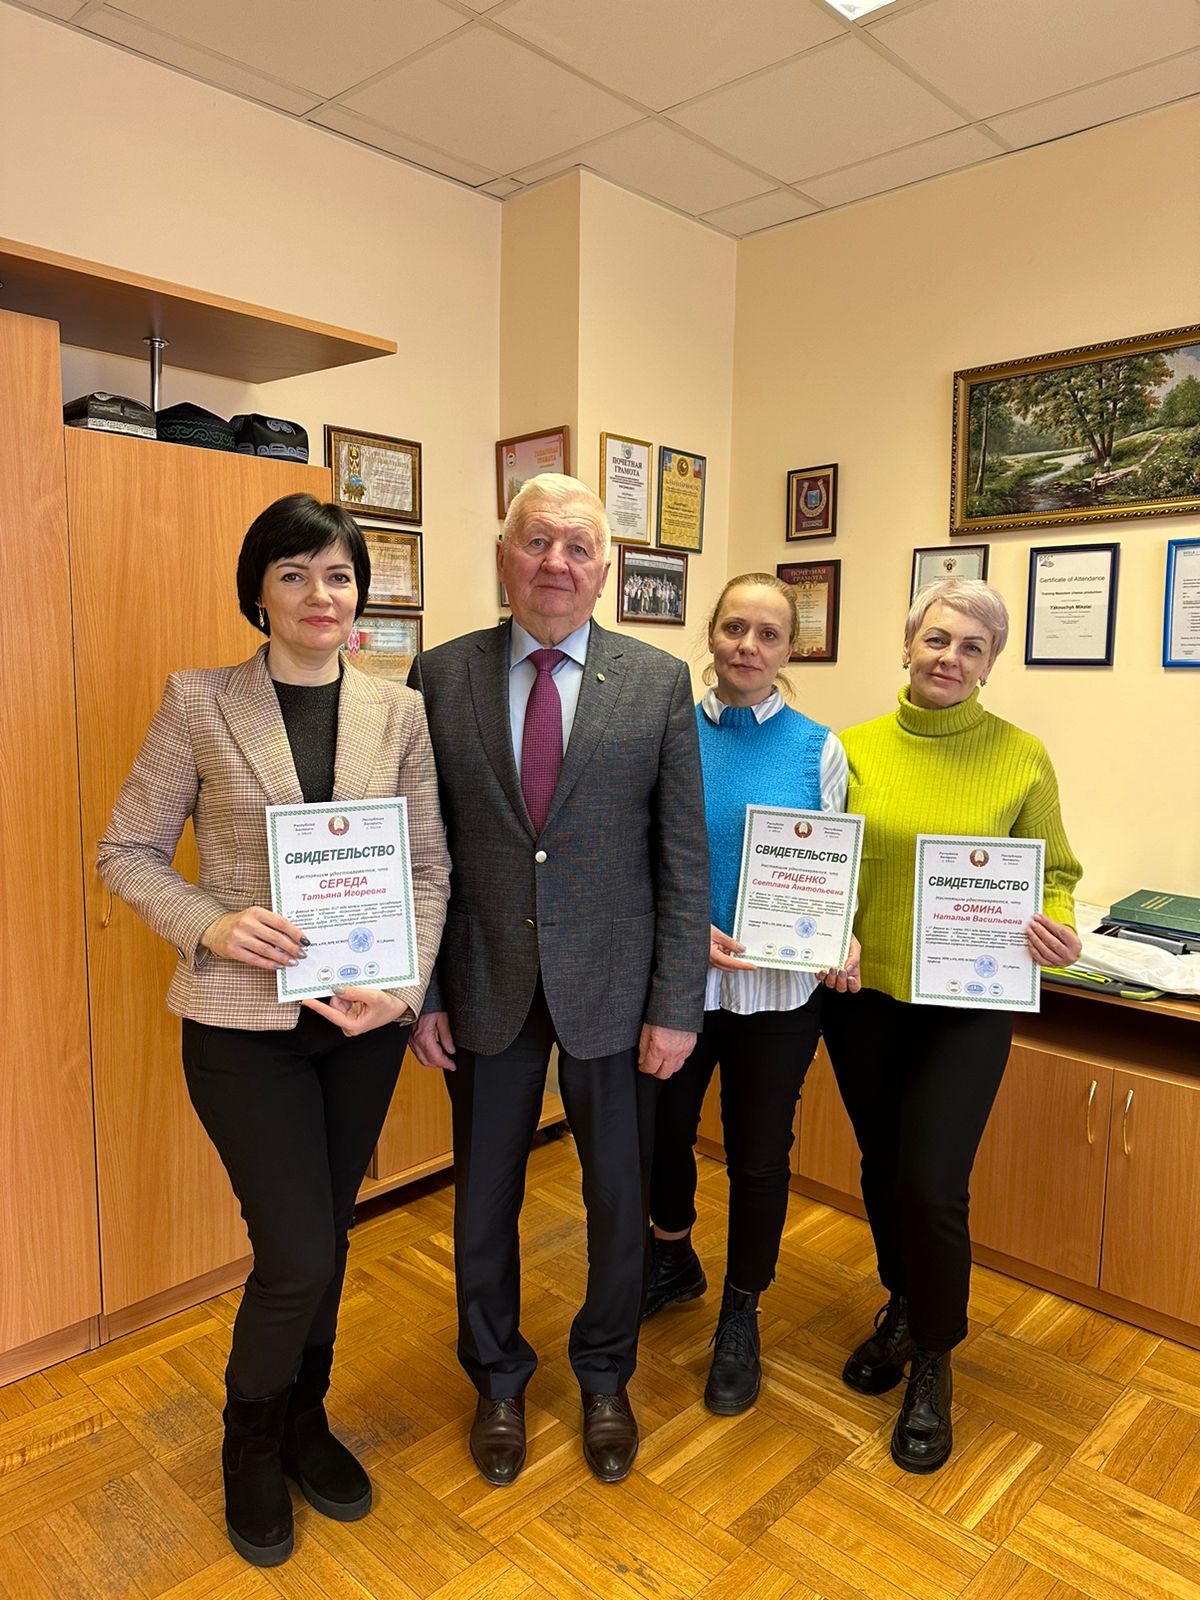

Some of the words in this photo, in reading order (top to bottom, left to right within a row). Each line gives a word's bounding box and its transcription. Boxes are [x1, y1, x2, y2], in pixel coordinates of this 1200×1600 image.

[614, 465, 640, 477] ГРАМОТА
[793, 574, 823, 582] ГРАМОТА
[285, 844, 395, 865] СВИДЕТЕЛЬСТВО
[755, 844, 848, 864] СВИДЕТЕЛЬСТВО
[296, 872, 329, 880] Настоящим
[319, 876, 368, 889] СЕРЕДА
[771, 871, 826, 885] ГРИЦЕНКО
[752, 878, 790, 889] Светлана
[791, 884, 844, 896] Анатольевна
[928, 876, 1029, 891] СВИДЕТЕЛЬСТВО
[302, 890, 342, 901] Татьяна
[344, 887, 386, 898] Игоревна
[953, 903, 1003, 915] ФОМИНА
[933, 913, 971, 921] Наталья
[972, 915, 1023, 925] Васильевна
